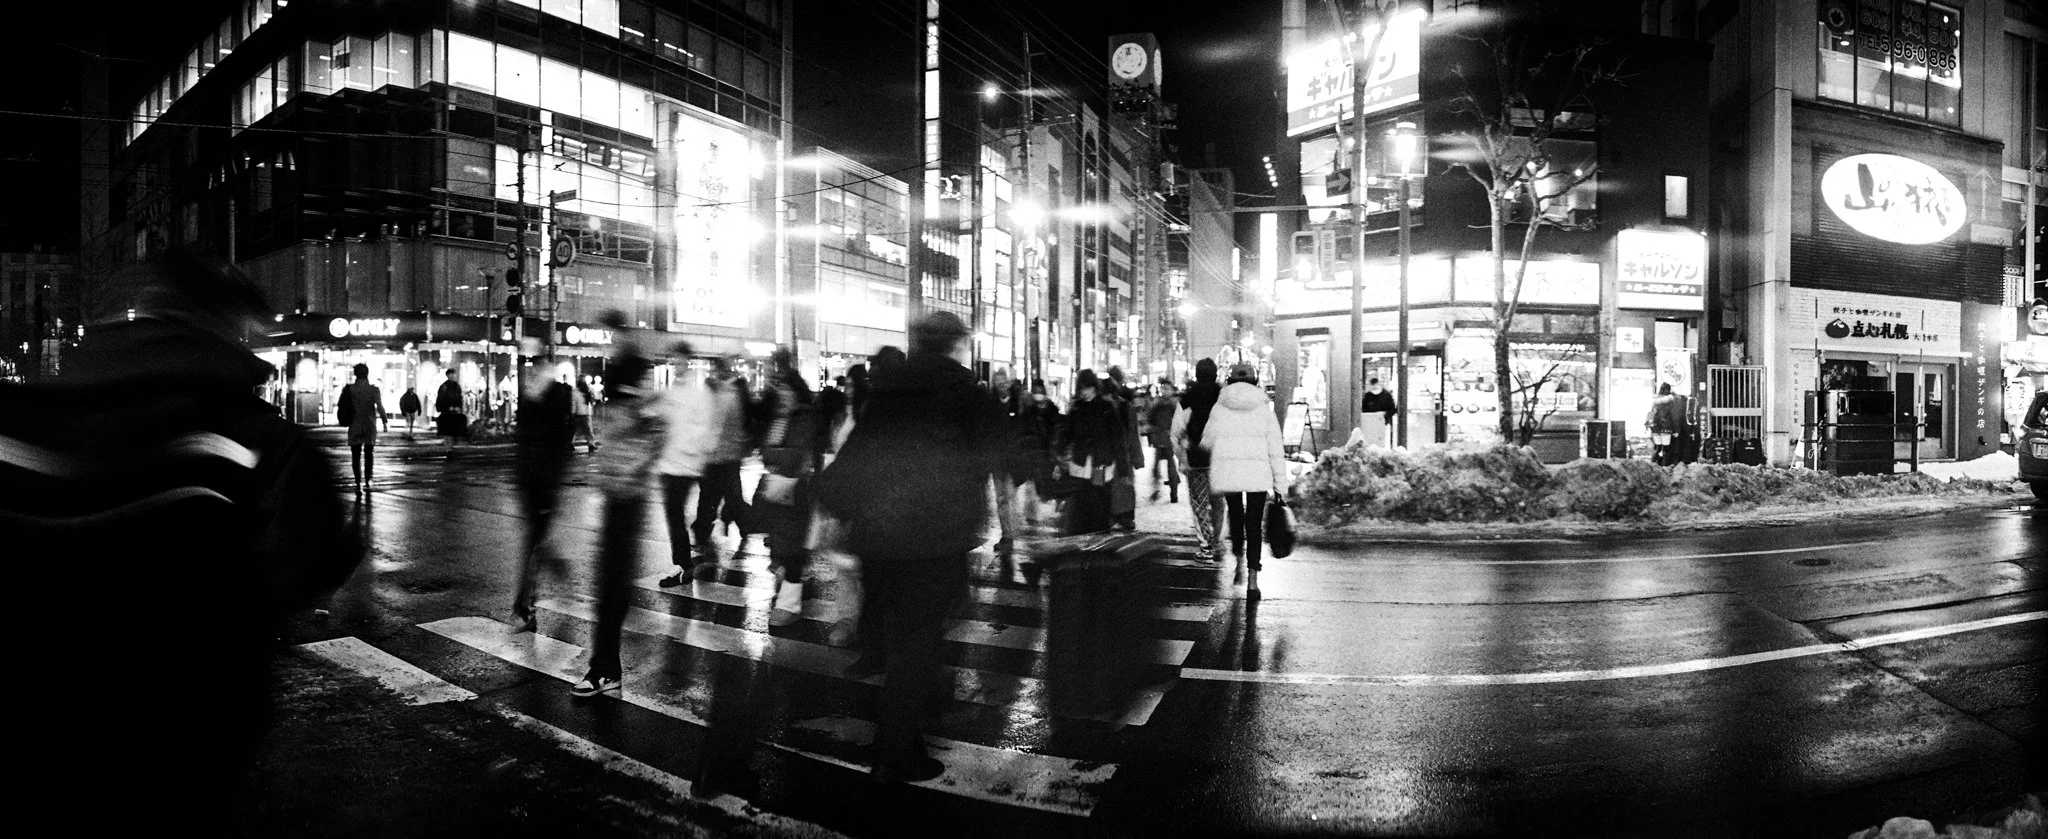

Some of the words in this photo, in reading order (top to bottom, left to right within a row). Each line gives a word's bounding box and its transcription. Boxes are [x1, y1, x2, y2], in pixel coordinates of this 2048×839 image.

[349, 318, 400, 336] ONLY
[580, 328, 613, 344] ONLY
[1851, 320, 1909, 340] 点心札幌
